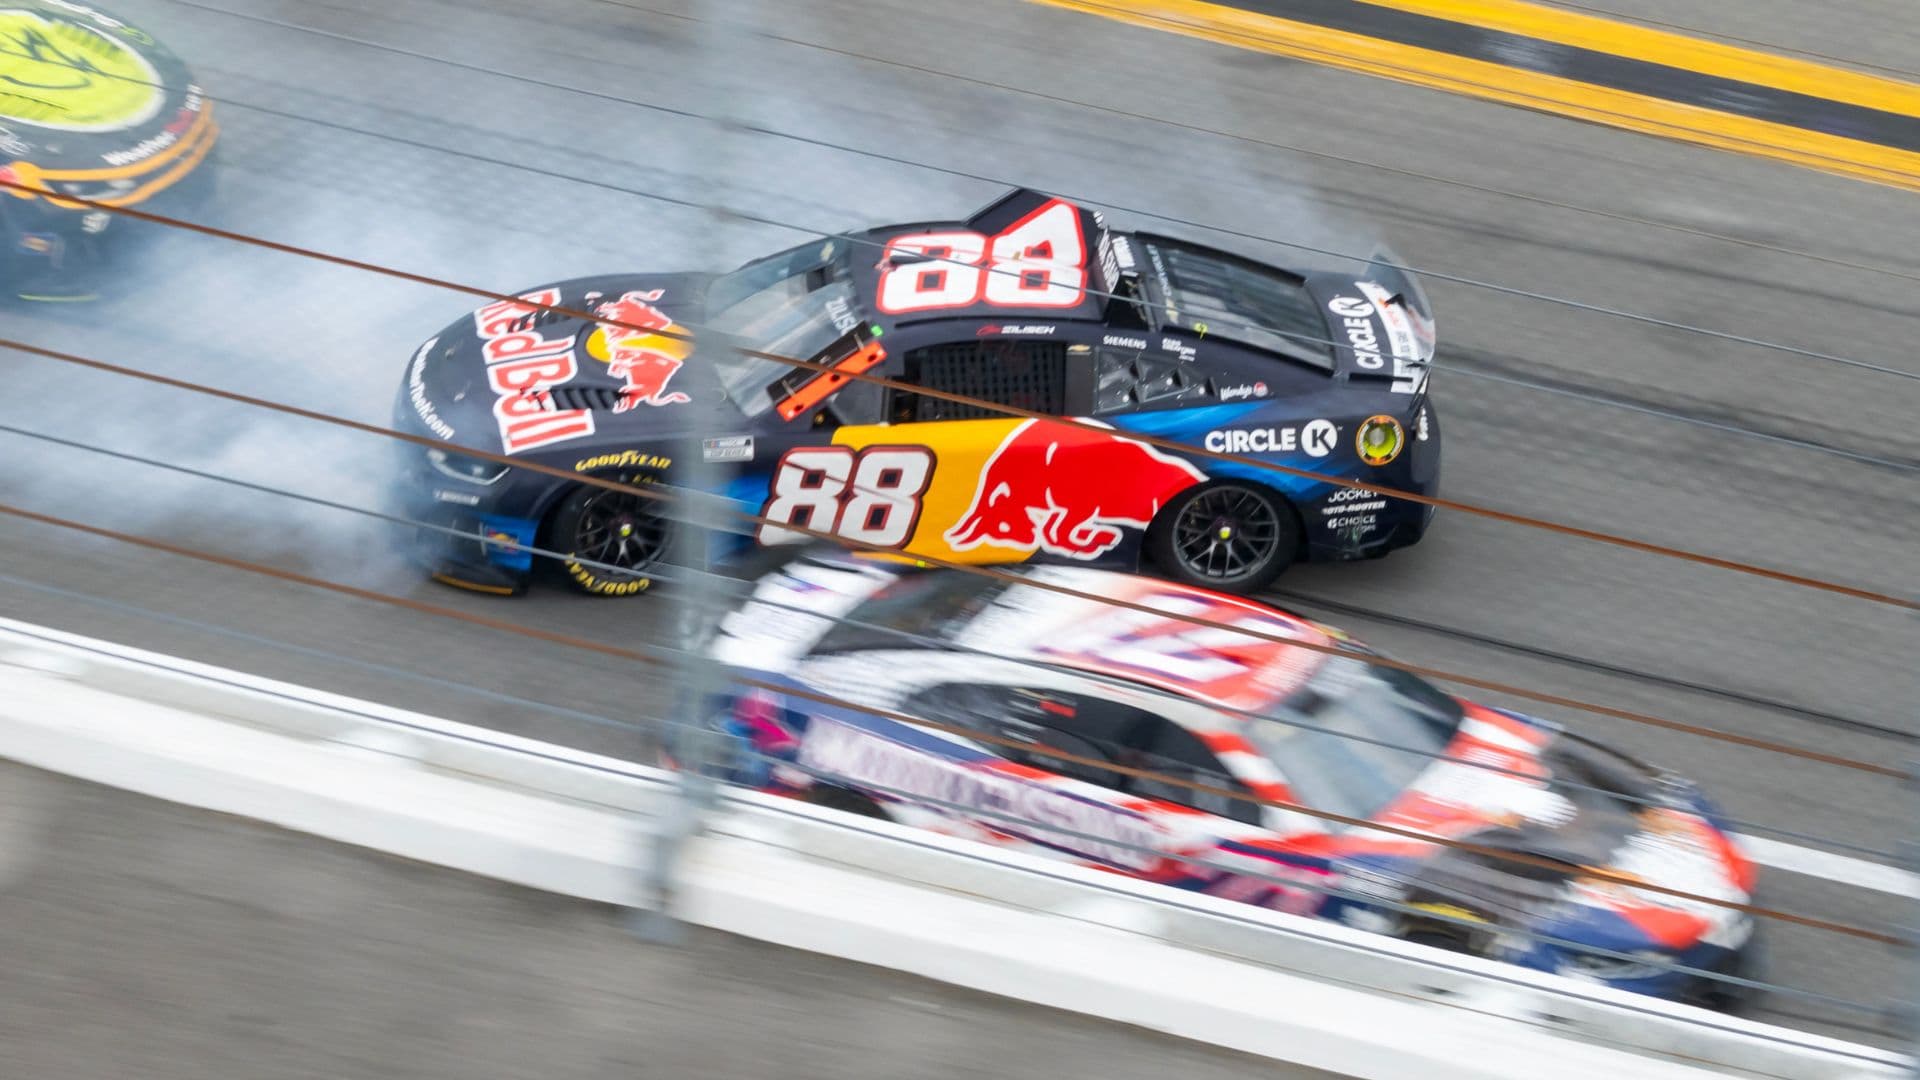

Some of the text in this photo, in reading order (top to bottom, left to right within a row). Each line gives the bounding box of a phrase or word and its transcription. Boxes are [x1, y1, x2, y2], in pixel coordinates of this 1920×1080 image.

[876, 197, 1088, 315] 88
[1103, 335, 1148, 350] SIEMENS
[1343, 317, 1385, 370] CIRCLE
[486, 349, 596, 456] Bull
[574, 449, 672, 473] GOODYEAR
[1204, 427, 1297, 454] CIRCLE
[755, 445, 938, 552] 88
